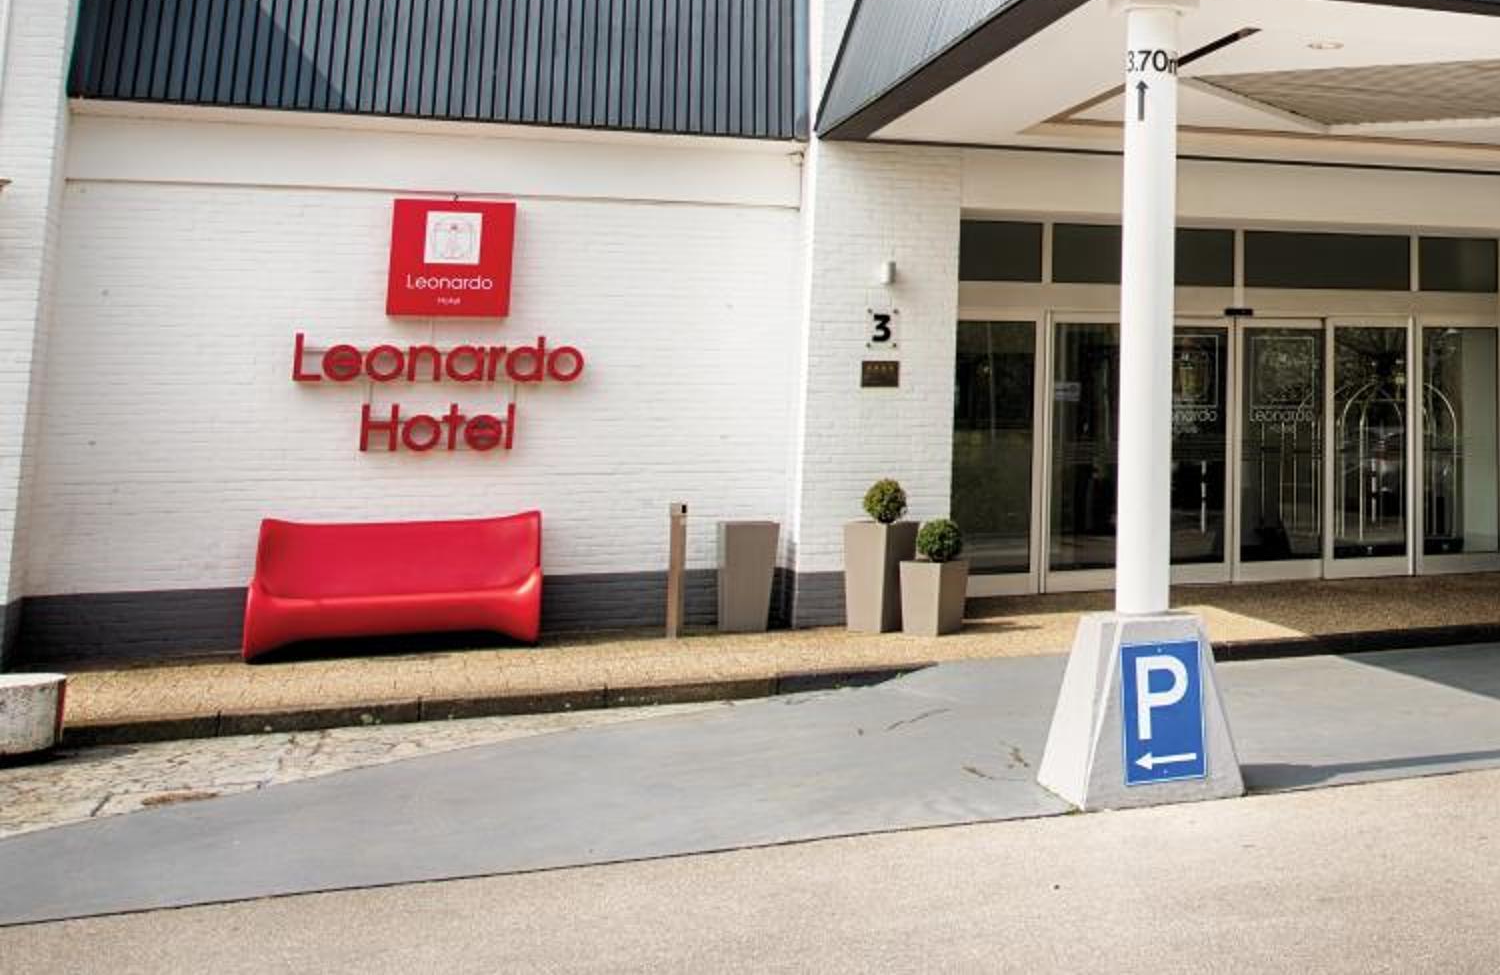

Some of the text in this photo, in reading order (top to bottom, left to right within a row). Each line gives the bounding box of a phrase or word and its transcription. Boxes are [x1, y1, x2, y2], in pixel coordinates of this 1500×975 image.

[406, 273, 493, 290] Leonardo
[871, 314, 892, 342] 3
[292, 333, 585, 383] Leonardo
[360, 403, 516, 452] Hotel
[1135, 654, 1189, 740] P
